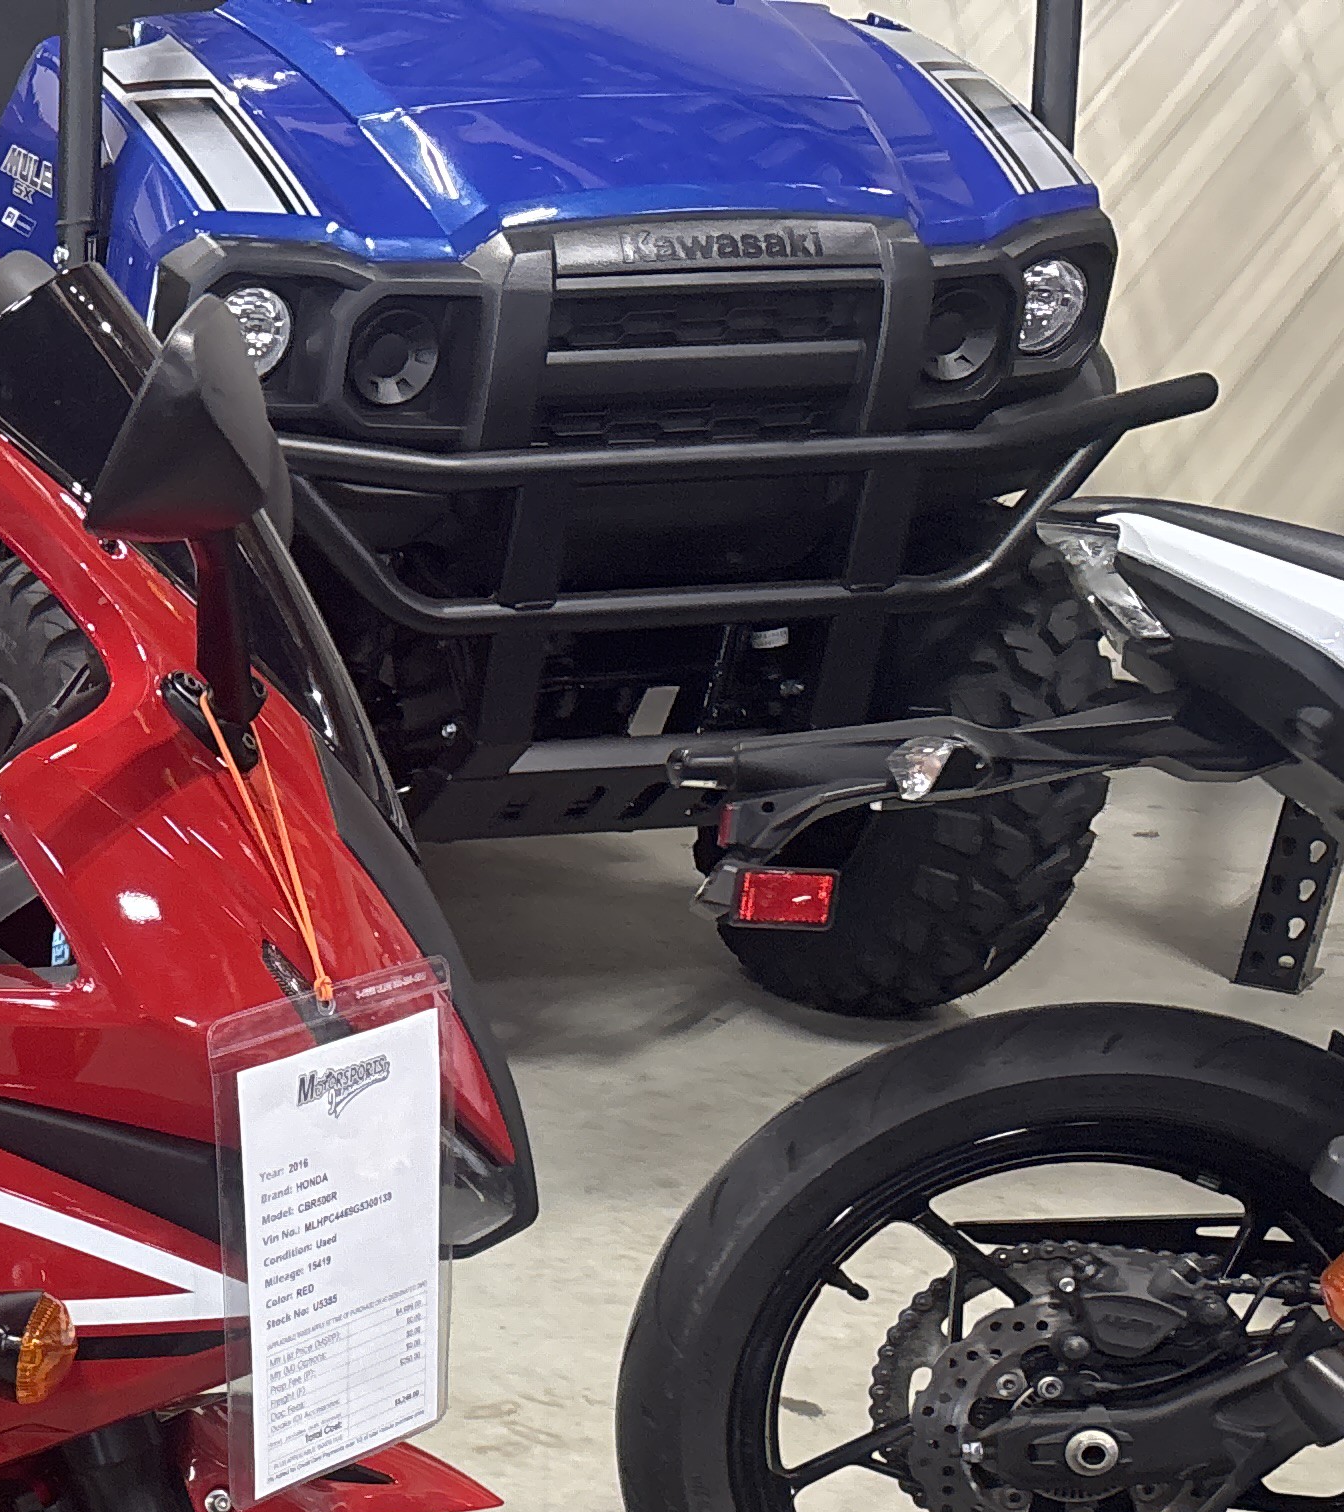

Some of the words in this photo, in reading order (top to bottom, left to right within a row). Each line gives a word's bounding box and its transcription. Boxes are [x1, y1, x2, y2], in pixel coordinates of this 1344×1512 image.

[0, 144, 53, 198] MULE
[12, 180, 33, 205] SX
[621, 228, 825, 265] Kawasaki
[259, 1166, 285, 1184] Year:
[288, 1158, 309, 1174] 2016
[260, 1185, 293, 1205] Brand:
[295, 1172, 329, 1193] HONDA
[261, 1206, 295, 1226] Model:
[262, 1232, 280, 1247] Vin
[263, 1242, 313, 1269] Condition:
[315, 1233, 337, 1250] Used
[264, 1266, 304, 1291] Mileage:
[265, 1292, 293, 1310] Color:
[296, 1283, 315, 1299] RED
[266, 1312, 292, 1330] Stock
[293, 1305, 309, 1320] No:
